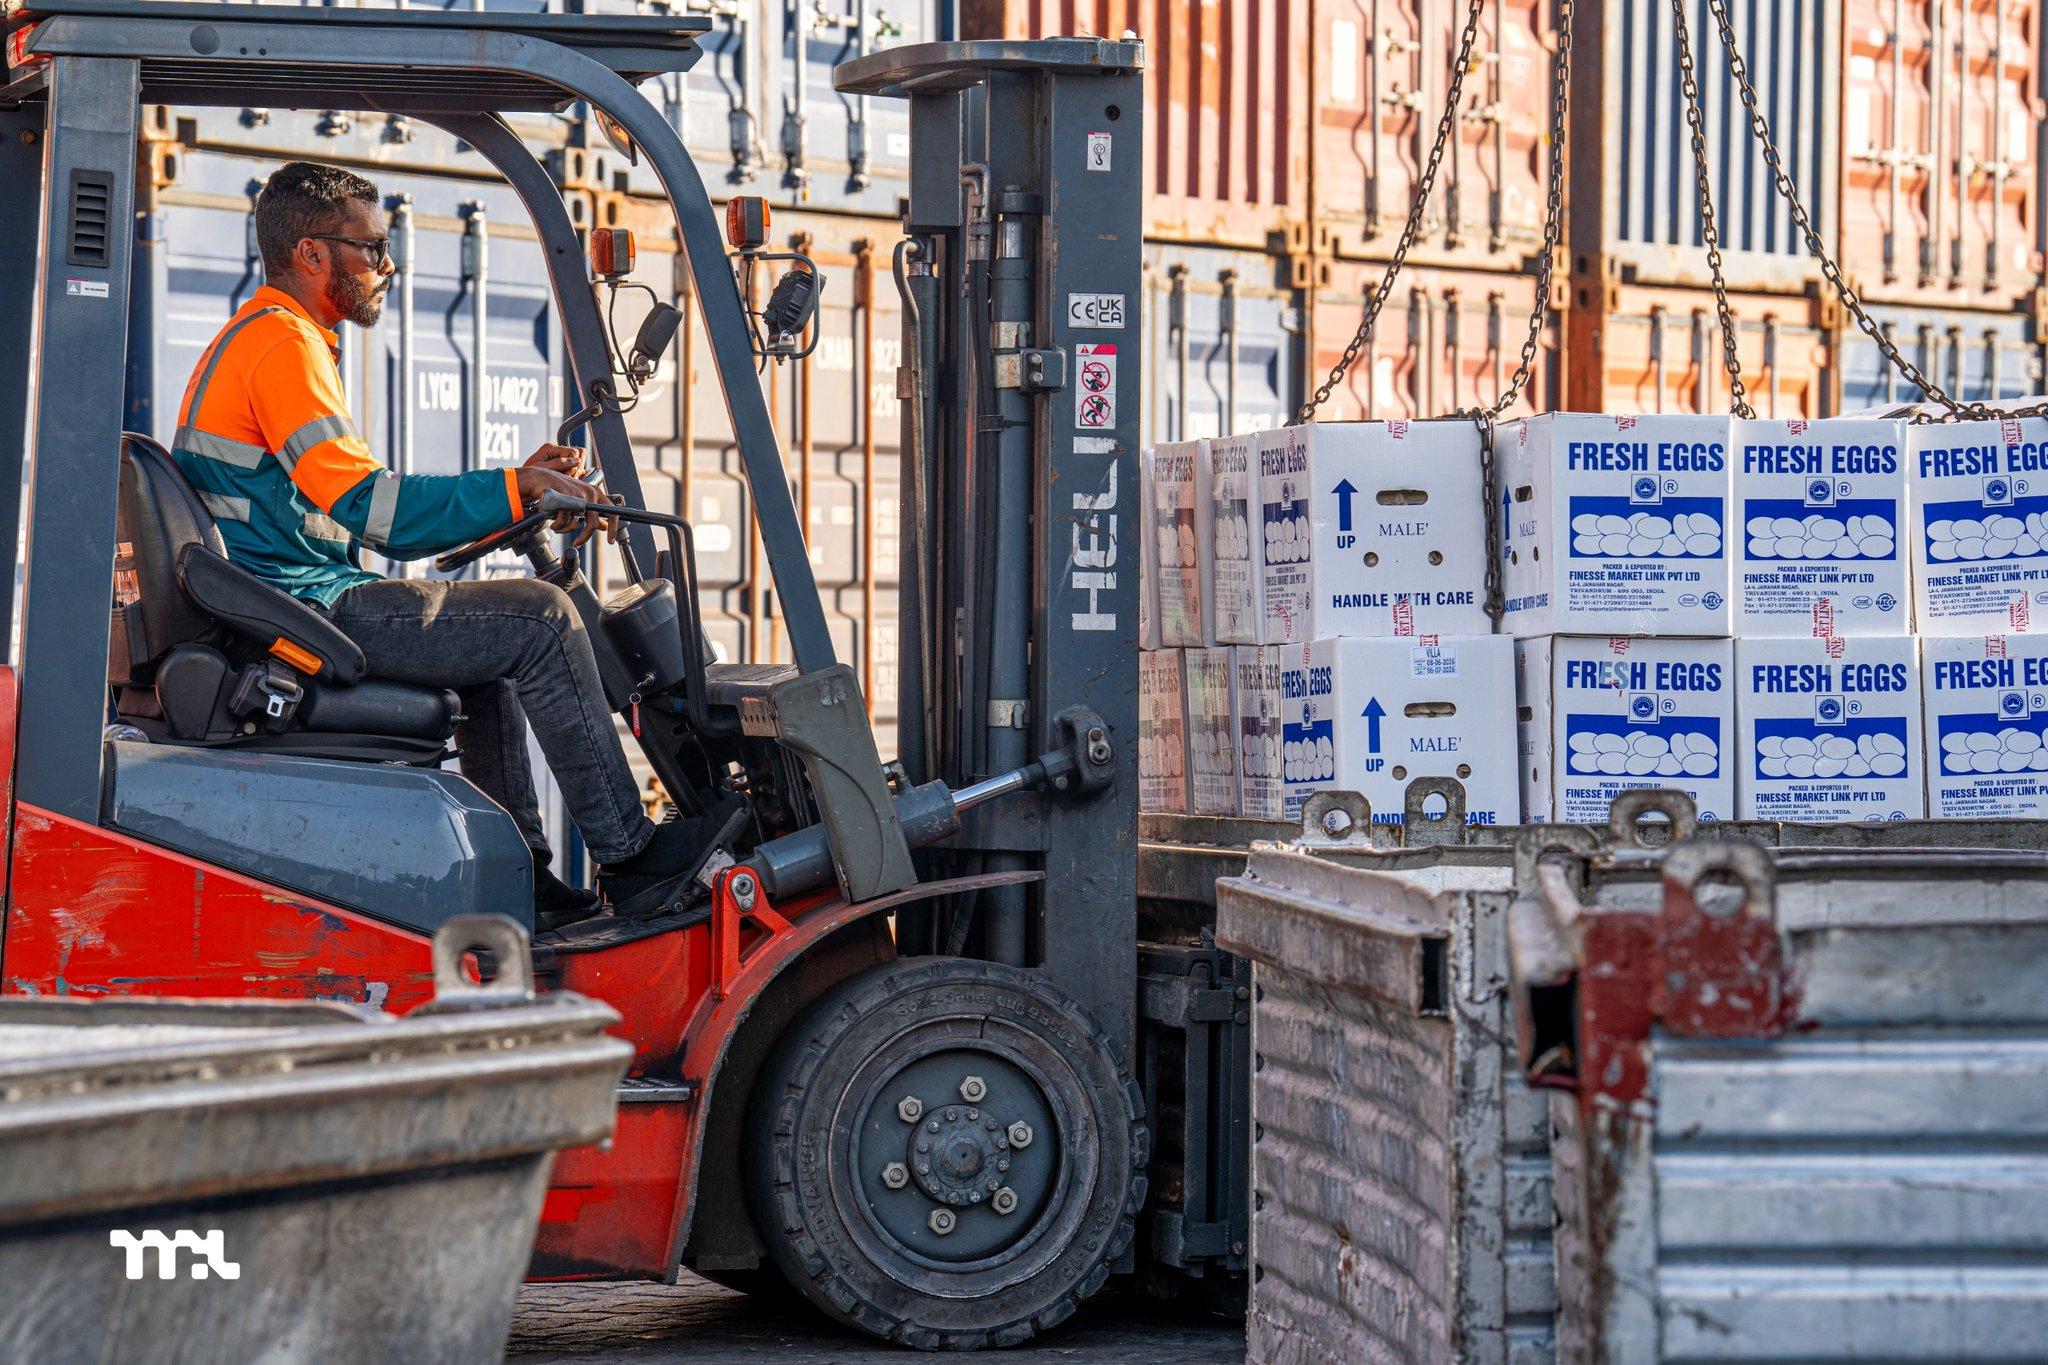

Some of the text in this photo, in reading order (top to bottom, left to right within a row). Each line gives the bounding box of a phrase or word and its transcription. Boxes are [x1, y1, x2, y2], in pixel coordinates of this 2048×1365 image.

[1071, 299, 1122, 320] CE UK
[1099, 312, 1122, 323] CA
[418, 372, 461, 411] LYGU
[1261, 449, 1285, 477] FRESH
[1568, 442, 1724, 472] FRESH EGGS
[1744, 445, 1897, 474] FRESH EGGS
[1919, 447, 1998, 478] FRESH
[1072, 436, 1118, 631] HELI
[1336, 535, 1356, 549] UP
[1569, 570, 1700, 582] FINESSE MARKET LINK PVT LTD
[1744, 573, 1874, 583] FINESSE MARKET LINK PVT LTD
[1927, 570, 2039, 587] FINESSE MARKET LINK PVT
[1332, 594, 1388, 608] HANDLE
[1436, 591, 1474, 606] CARE
[1504, 597, 1522, 613] ANDLE
[1281, 666, 1332, 699] FRESH EGGS
[1567, 660, 1722, 692] FRESH EGGS
[1753, 663, 1907, 693] FRESH EGGS
[1935, 658, 2014, 690] FRESH
[1366, 758, 1384, 772] UP
[1566, 788, 1601, 798] FINESSE
[1756, 792, 1886, 803] FINESSE MARKET LINK PVT LTD
[1941, 786, 2037, 799] FINESSE MARKET LINK
[801, 1133, 838, 1245] ADVANCE
